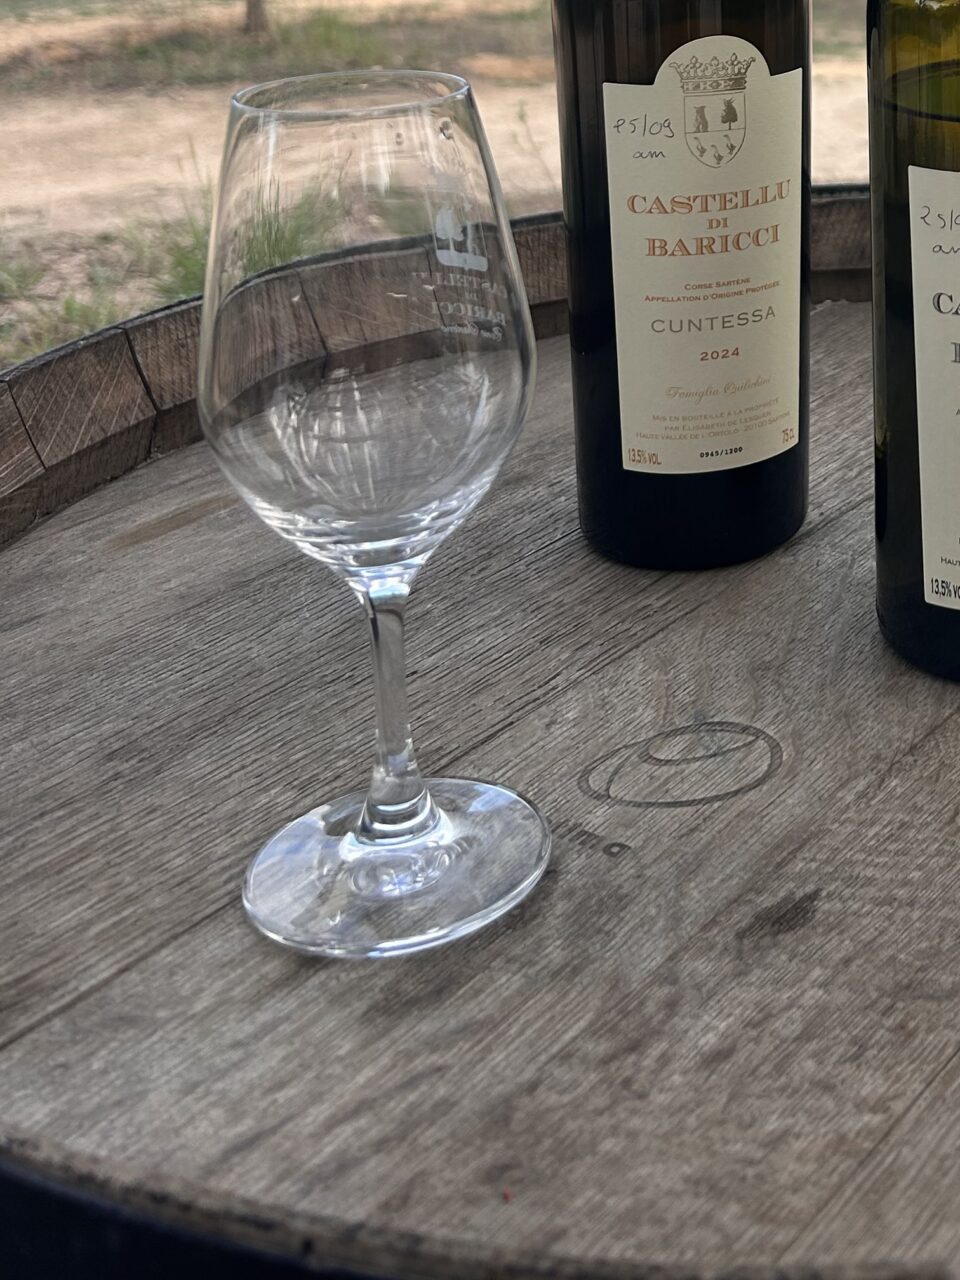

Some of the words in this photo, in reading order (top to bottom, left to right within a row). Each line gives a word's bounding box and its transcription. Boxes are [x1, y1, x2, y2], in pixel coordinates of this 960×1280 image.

[627, 179, 791, 214] CASTELLU
[706, 217, 728, 230] DI
[645, 224, 780, 257] BARICCI
[651, 306, 776, 334] CUNTESSA
[699, 347, 740, 362] 2024
